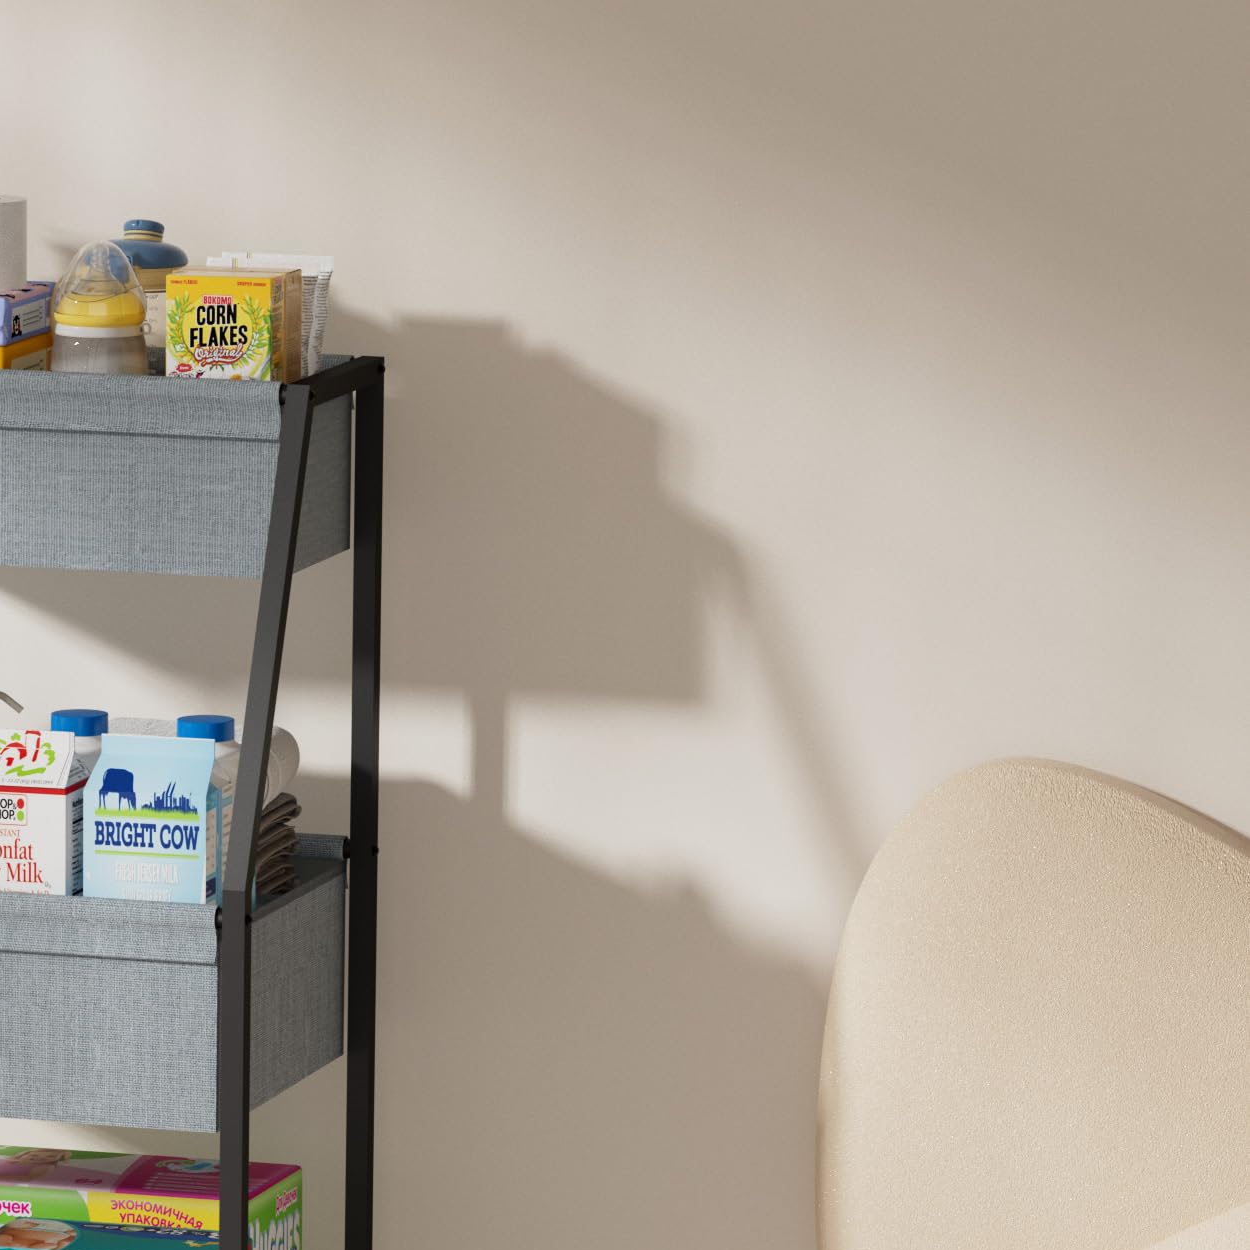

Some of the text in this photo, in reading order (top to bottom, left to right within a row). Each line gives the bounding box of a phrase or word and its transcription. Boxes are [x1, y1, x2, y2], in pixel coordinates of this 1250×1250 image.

[203, 295, 232, 305] BOKOMO
[196, 303, 237, 326] CORN
[189, 325, 248, 348] FLAKES
[193, 343, 245, 366] Original
[94, 820, 200, 850] BRIGHT COW
[6, 862, 44, 884] Milk
[111, 1200, 203, 1230] ЭКОНОМИЧНАЯ
